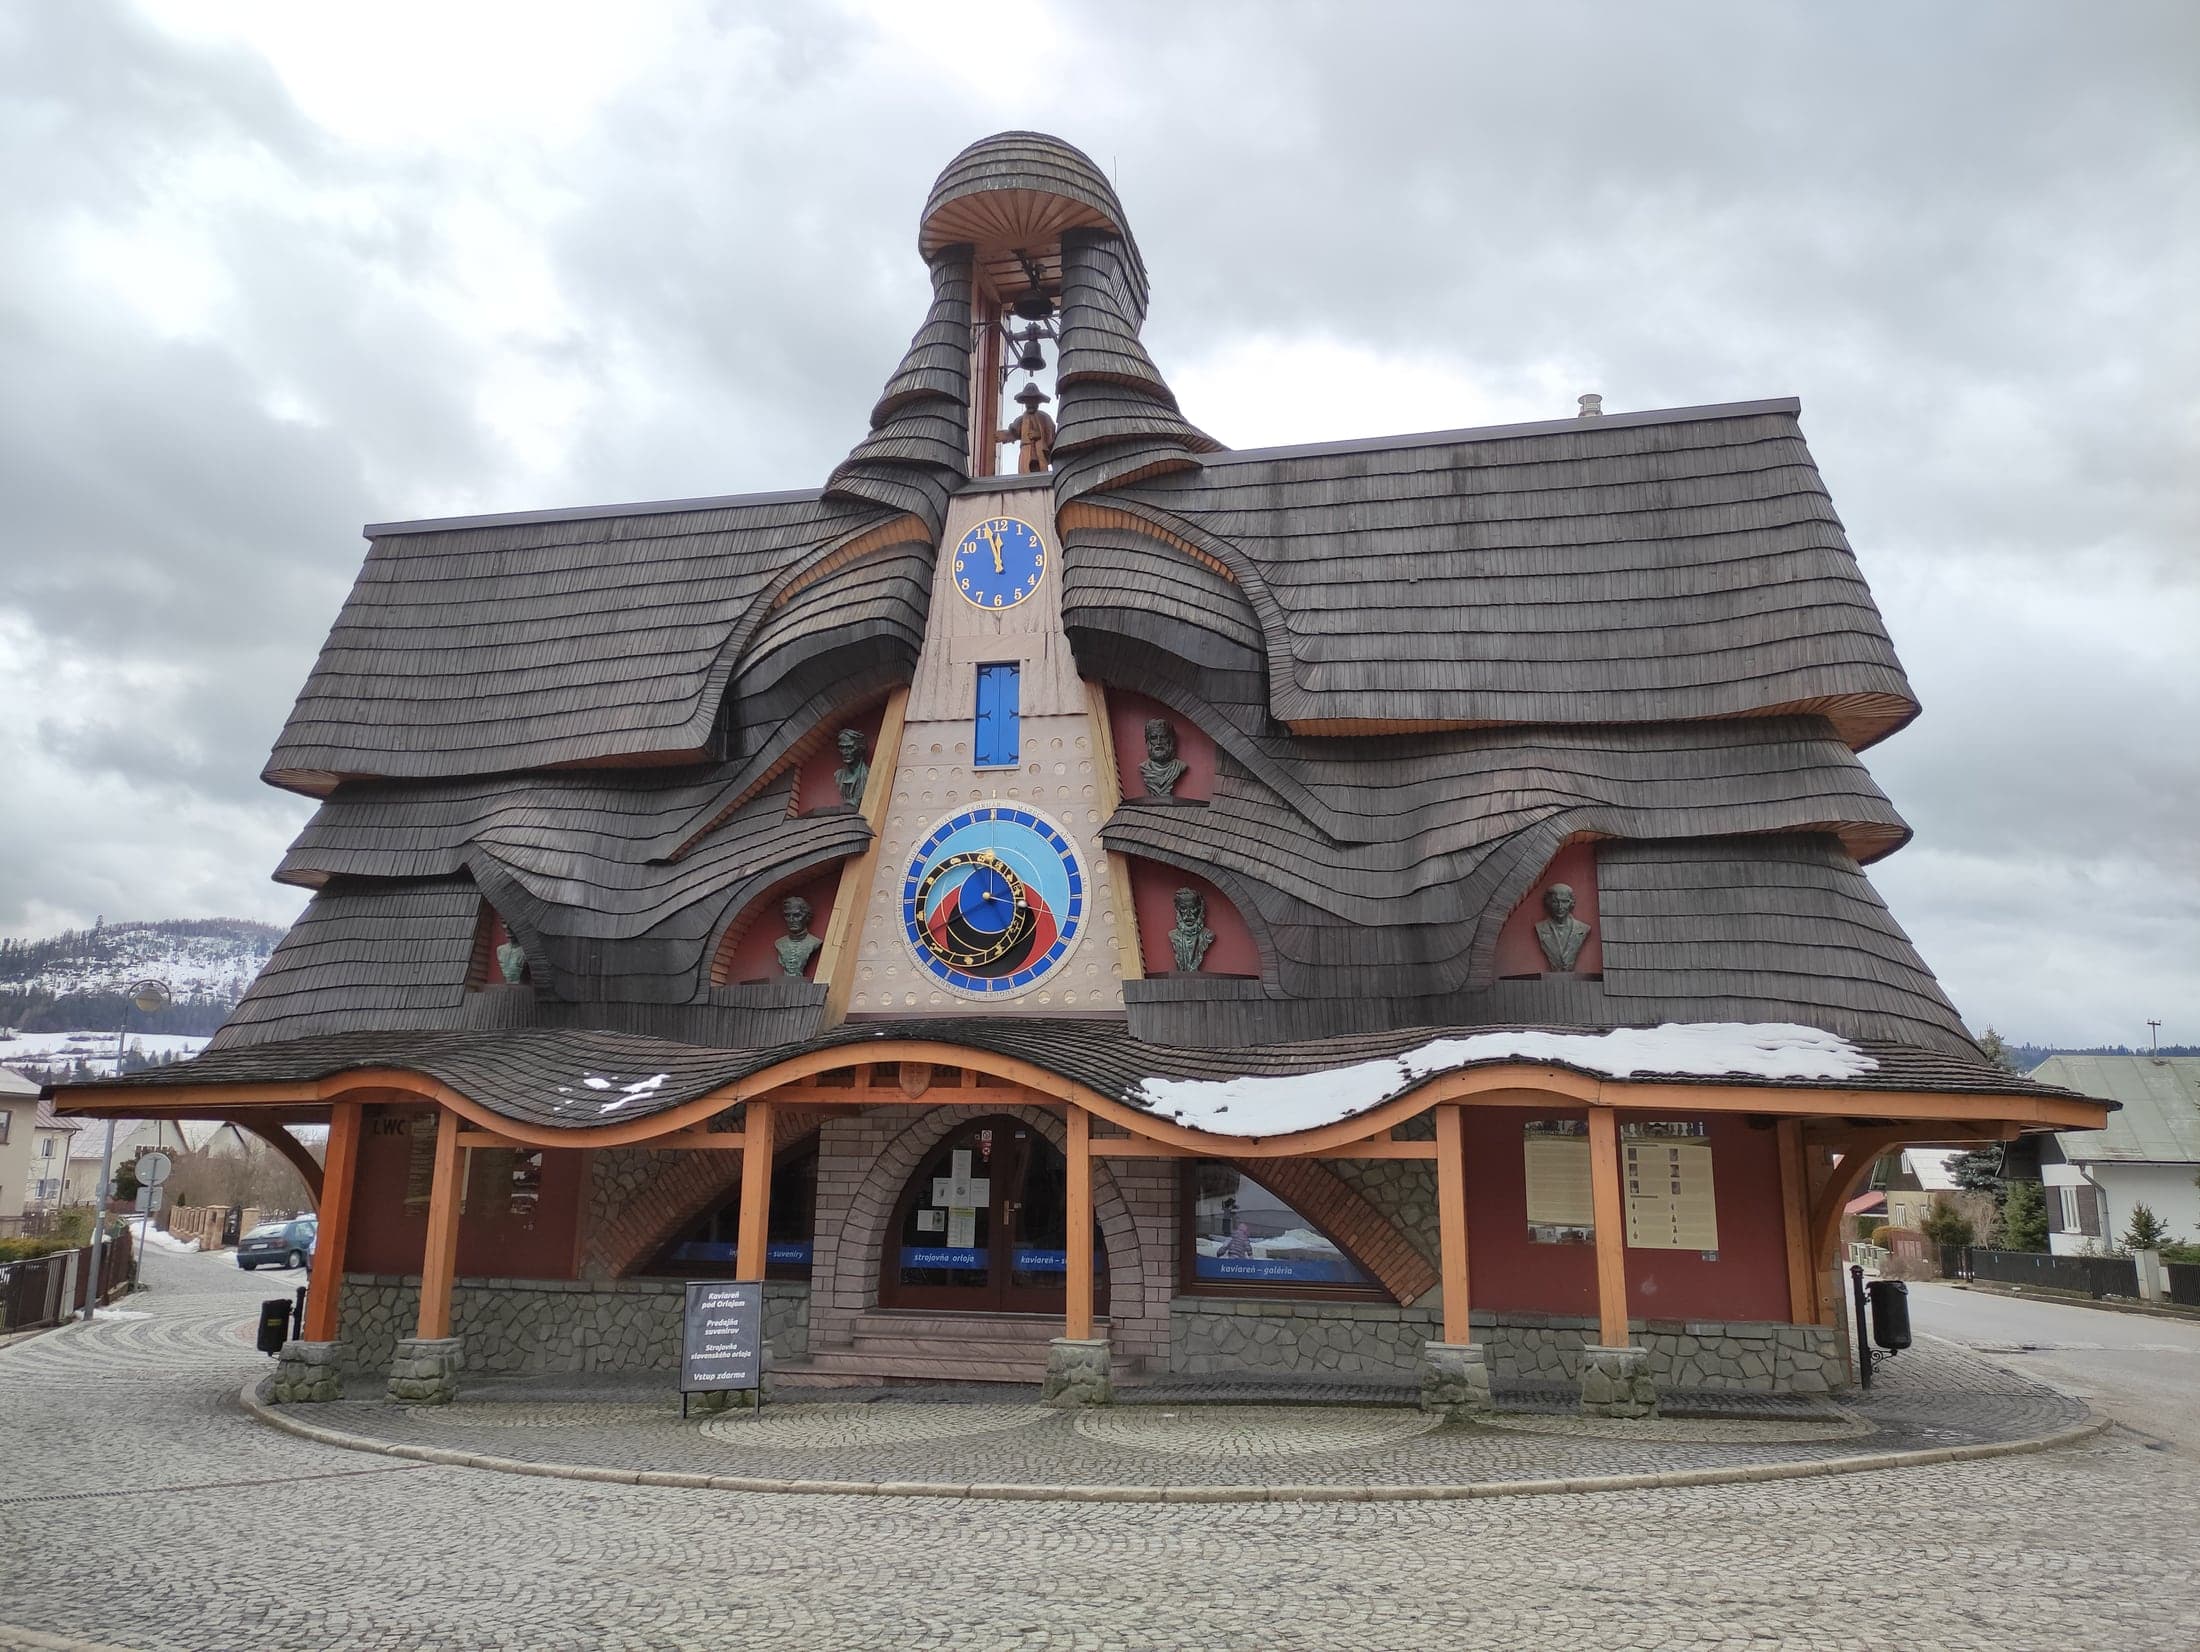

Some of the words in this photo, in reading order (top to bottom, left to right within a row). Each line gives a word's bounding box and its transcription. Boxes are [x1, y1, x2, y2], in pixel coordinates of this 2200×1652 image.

[993, 520, 1008, 531] 12
[1016, 524, 1023, 535] 1
[1029, 535, 1037, 547] 2
[962, 541, 977, 554] 10
[955, 560, 964, 572] 9
[1035, 554, 1043, 567] 3
[961, 578, 970, 590] 8
[1027, 573, 1036, 585] 4
[975, 591, 984, 603] 7
[993, 594, 1002, 606] 6
[1014, 588, 1022, 600] 5
[952, 1254, 974, 1263] orloja
[701, 1301, 716, 1310] pod
[716, 1300, 745, 1309] Orlojom
[690, 1351, 731, 1360] slovenského
[731, 1350, 752, 1358] orloja
[693, 1372, 716, 1381] Vstup
[716, 1371, 746, 1380] zdarma
